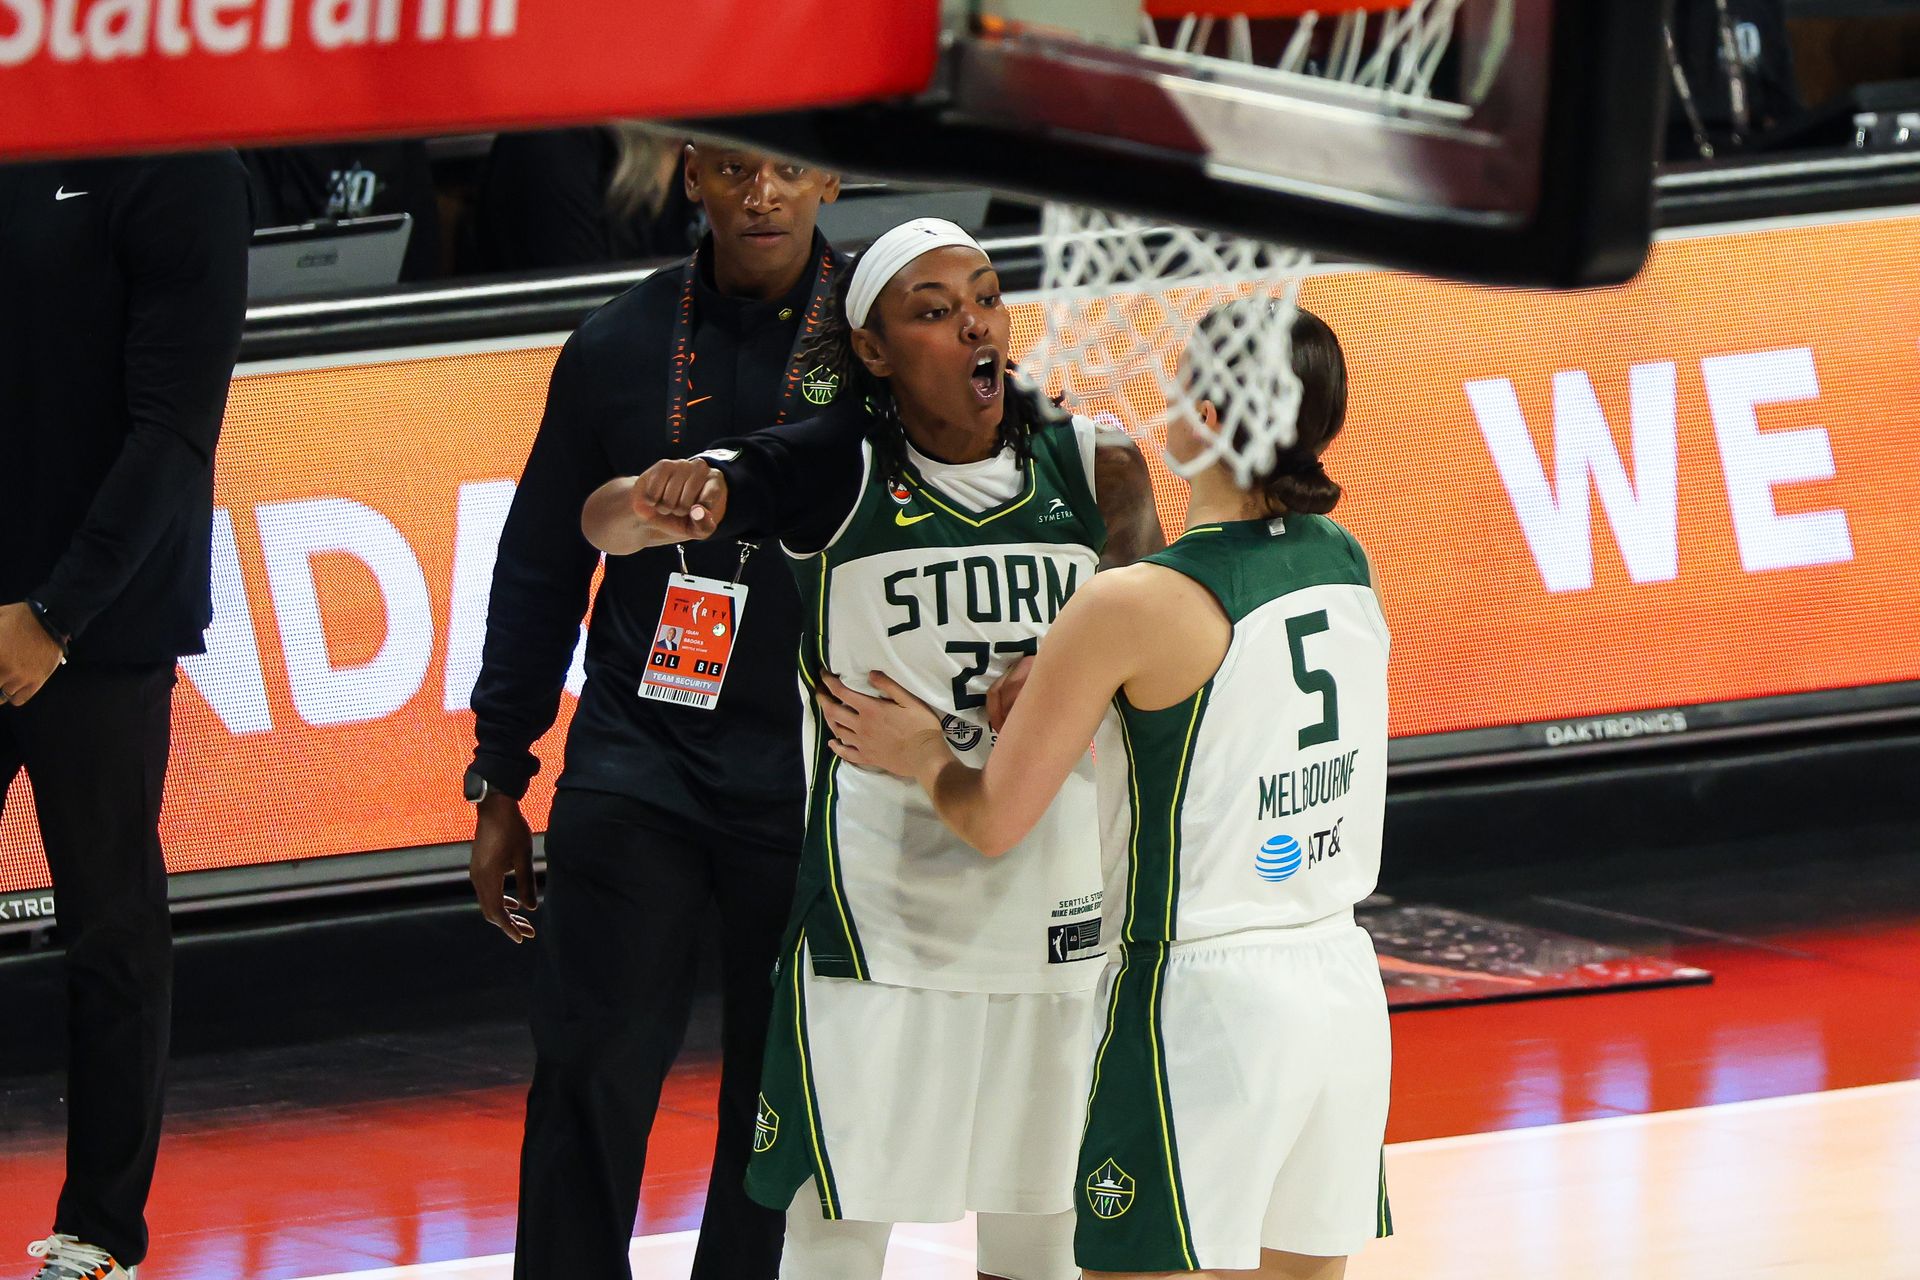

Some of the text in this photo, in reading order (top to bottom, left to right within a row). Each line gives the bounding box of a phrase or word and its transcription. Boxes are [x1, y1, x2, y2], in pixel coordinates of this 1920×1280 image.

[1464, 347, 1854, 594] WE
[1038, 510, 1074, 523] SYMETRA
[883, 554, 1077, 637] STORM
[652, 672, 713, 690] TEAM SECURITY
[1285, 608, 1339, 751] 5
[1545, 711, 1688, 746] DAKTRONICS
[1059, 896, 1089, 908] SEATTLE
